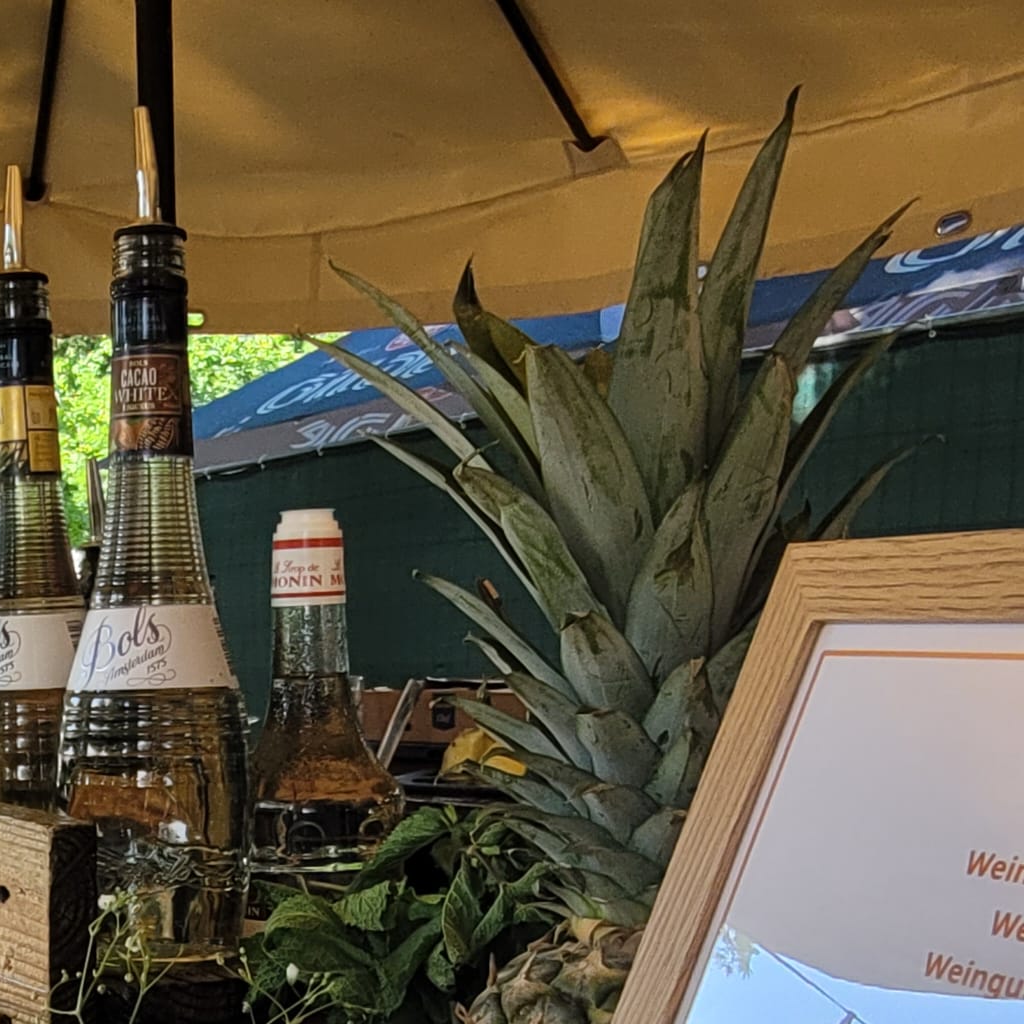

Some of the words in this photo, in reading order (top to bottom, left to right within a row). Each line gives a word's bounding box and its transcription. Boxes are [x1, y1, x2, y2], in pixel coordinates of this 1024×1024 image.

[120, 367, 158, 386] CACAO
[114, 386, 168, 404] WHITE
[81, 606, 161, 689] Bols
